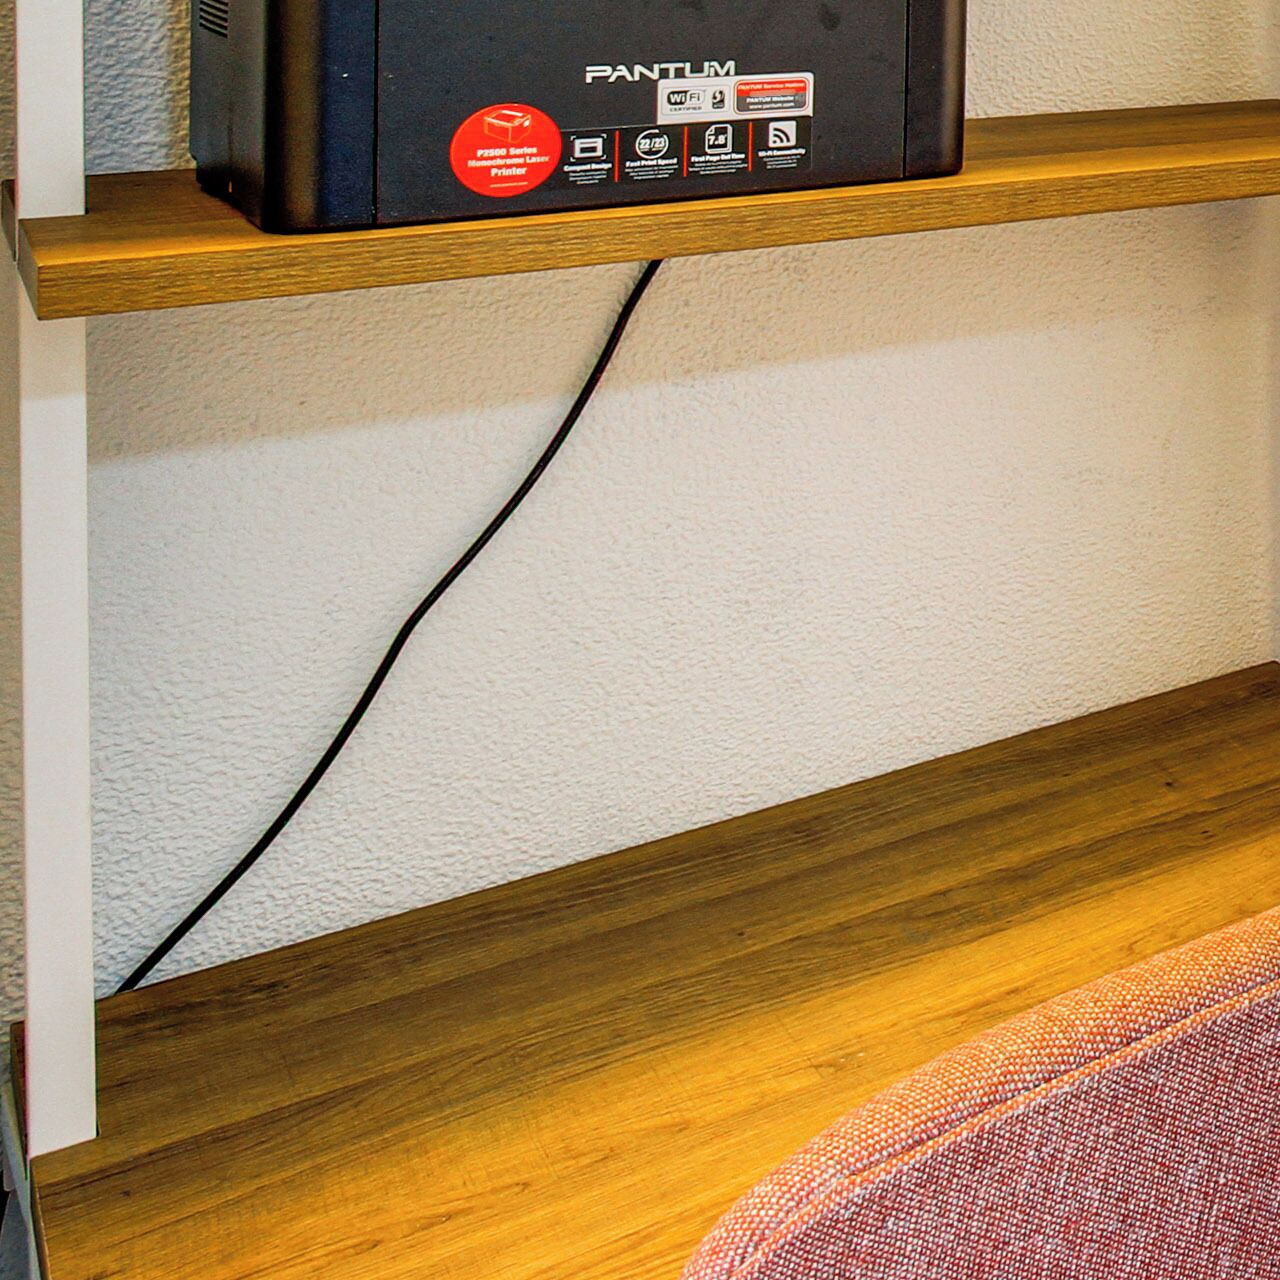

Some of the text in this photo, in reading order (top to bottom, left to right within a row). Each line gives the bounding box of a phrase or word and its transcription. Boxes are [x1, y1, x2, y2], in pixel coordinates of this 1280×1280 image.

[585, 60, 736, 84] PANTUM
[476, 146, 538, 157] P2500 Series
[467, 155, 550, 167] Monochrome Laser
[490, 167, 527, 177] Printer
